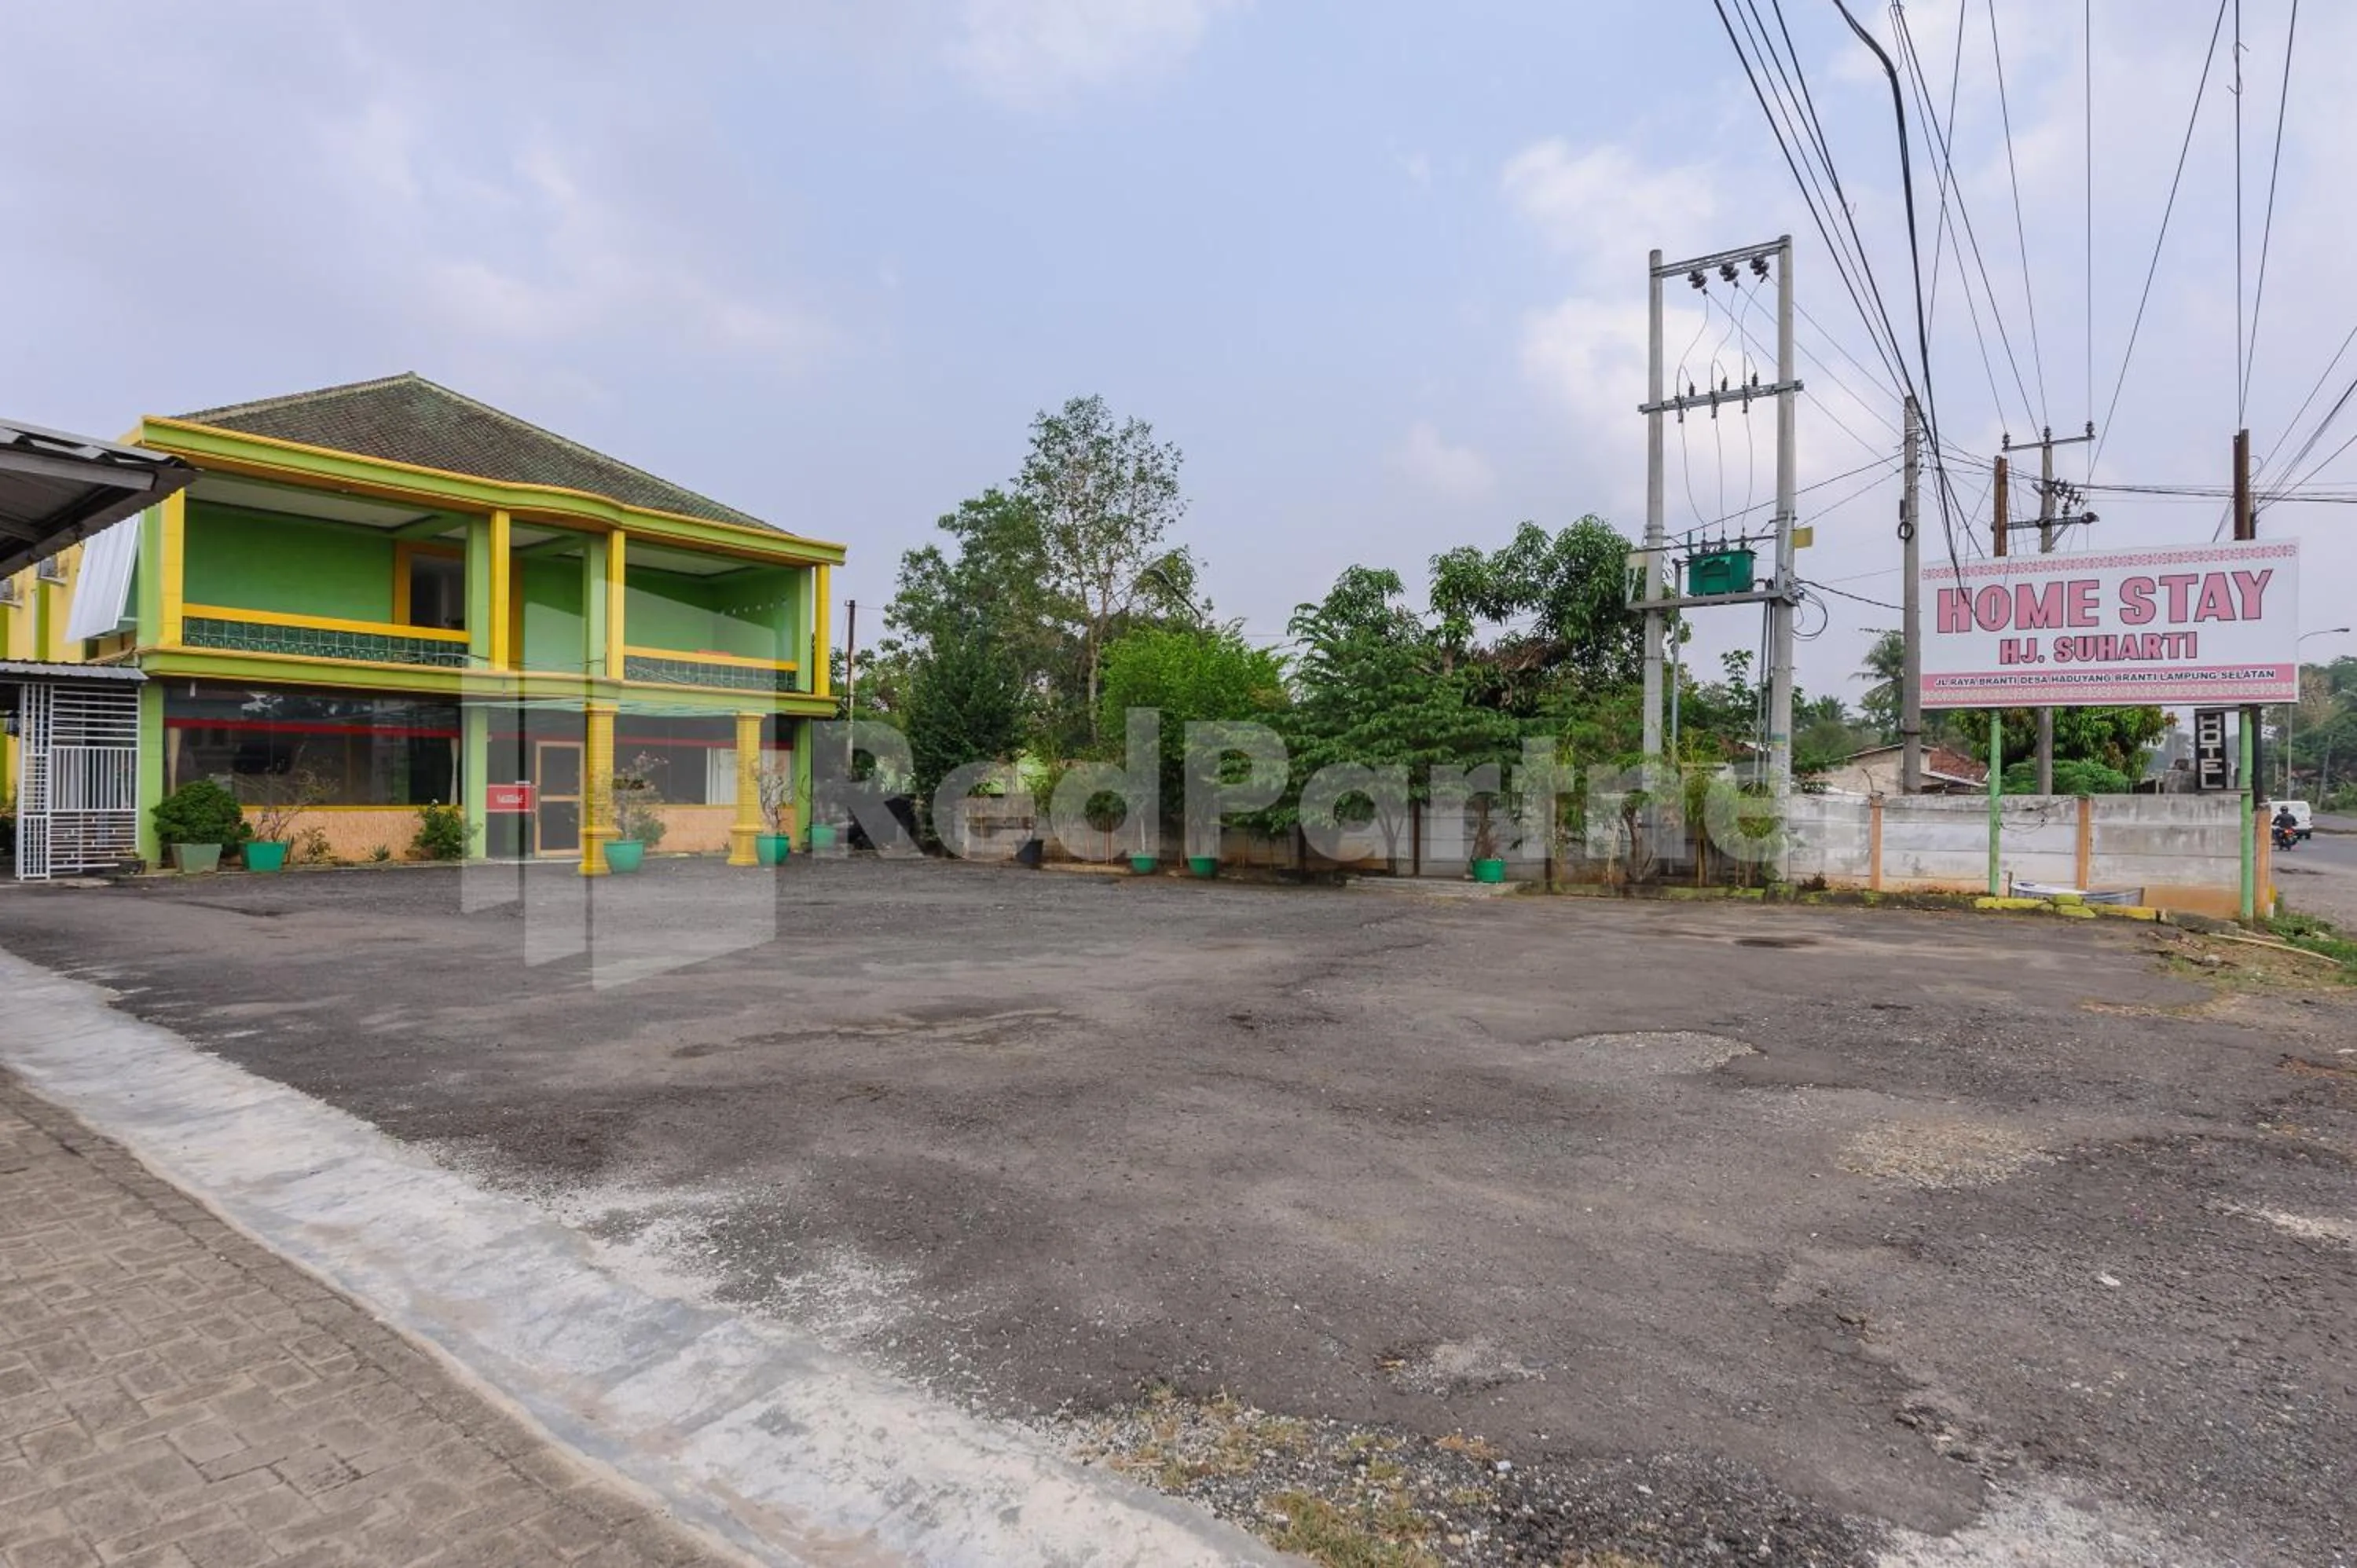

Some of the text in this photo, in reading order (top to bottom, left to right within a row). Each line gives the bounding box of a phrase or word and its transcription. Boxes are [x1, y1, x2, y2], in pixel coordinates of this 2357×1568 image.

[1937, 568, 2274, 634] HOME STAY
[1999, 631, 2198, 665] HJ. SUHARTI
[2020, 676, 2047, 684] DESA
[2115, 672, 2157, 682] BRANTI
[2161, 671, 2216, 681] LAMPUNG
[2221, 669, 2275, 680] SELATAN
[2199, 714, 2223, 789] HOTEL
